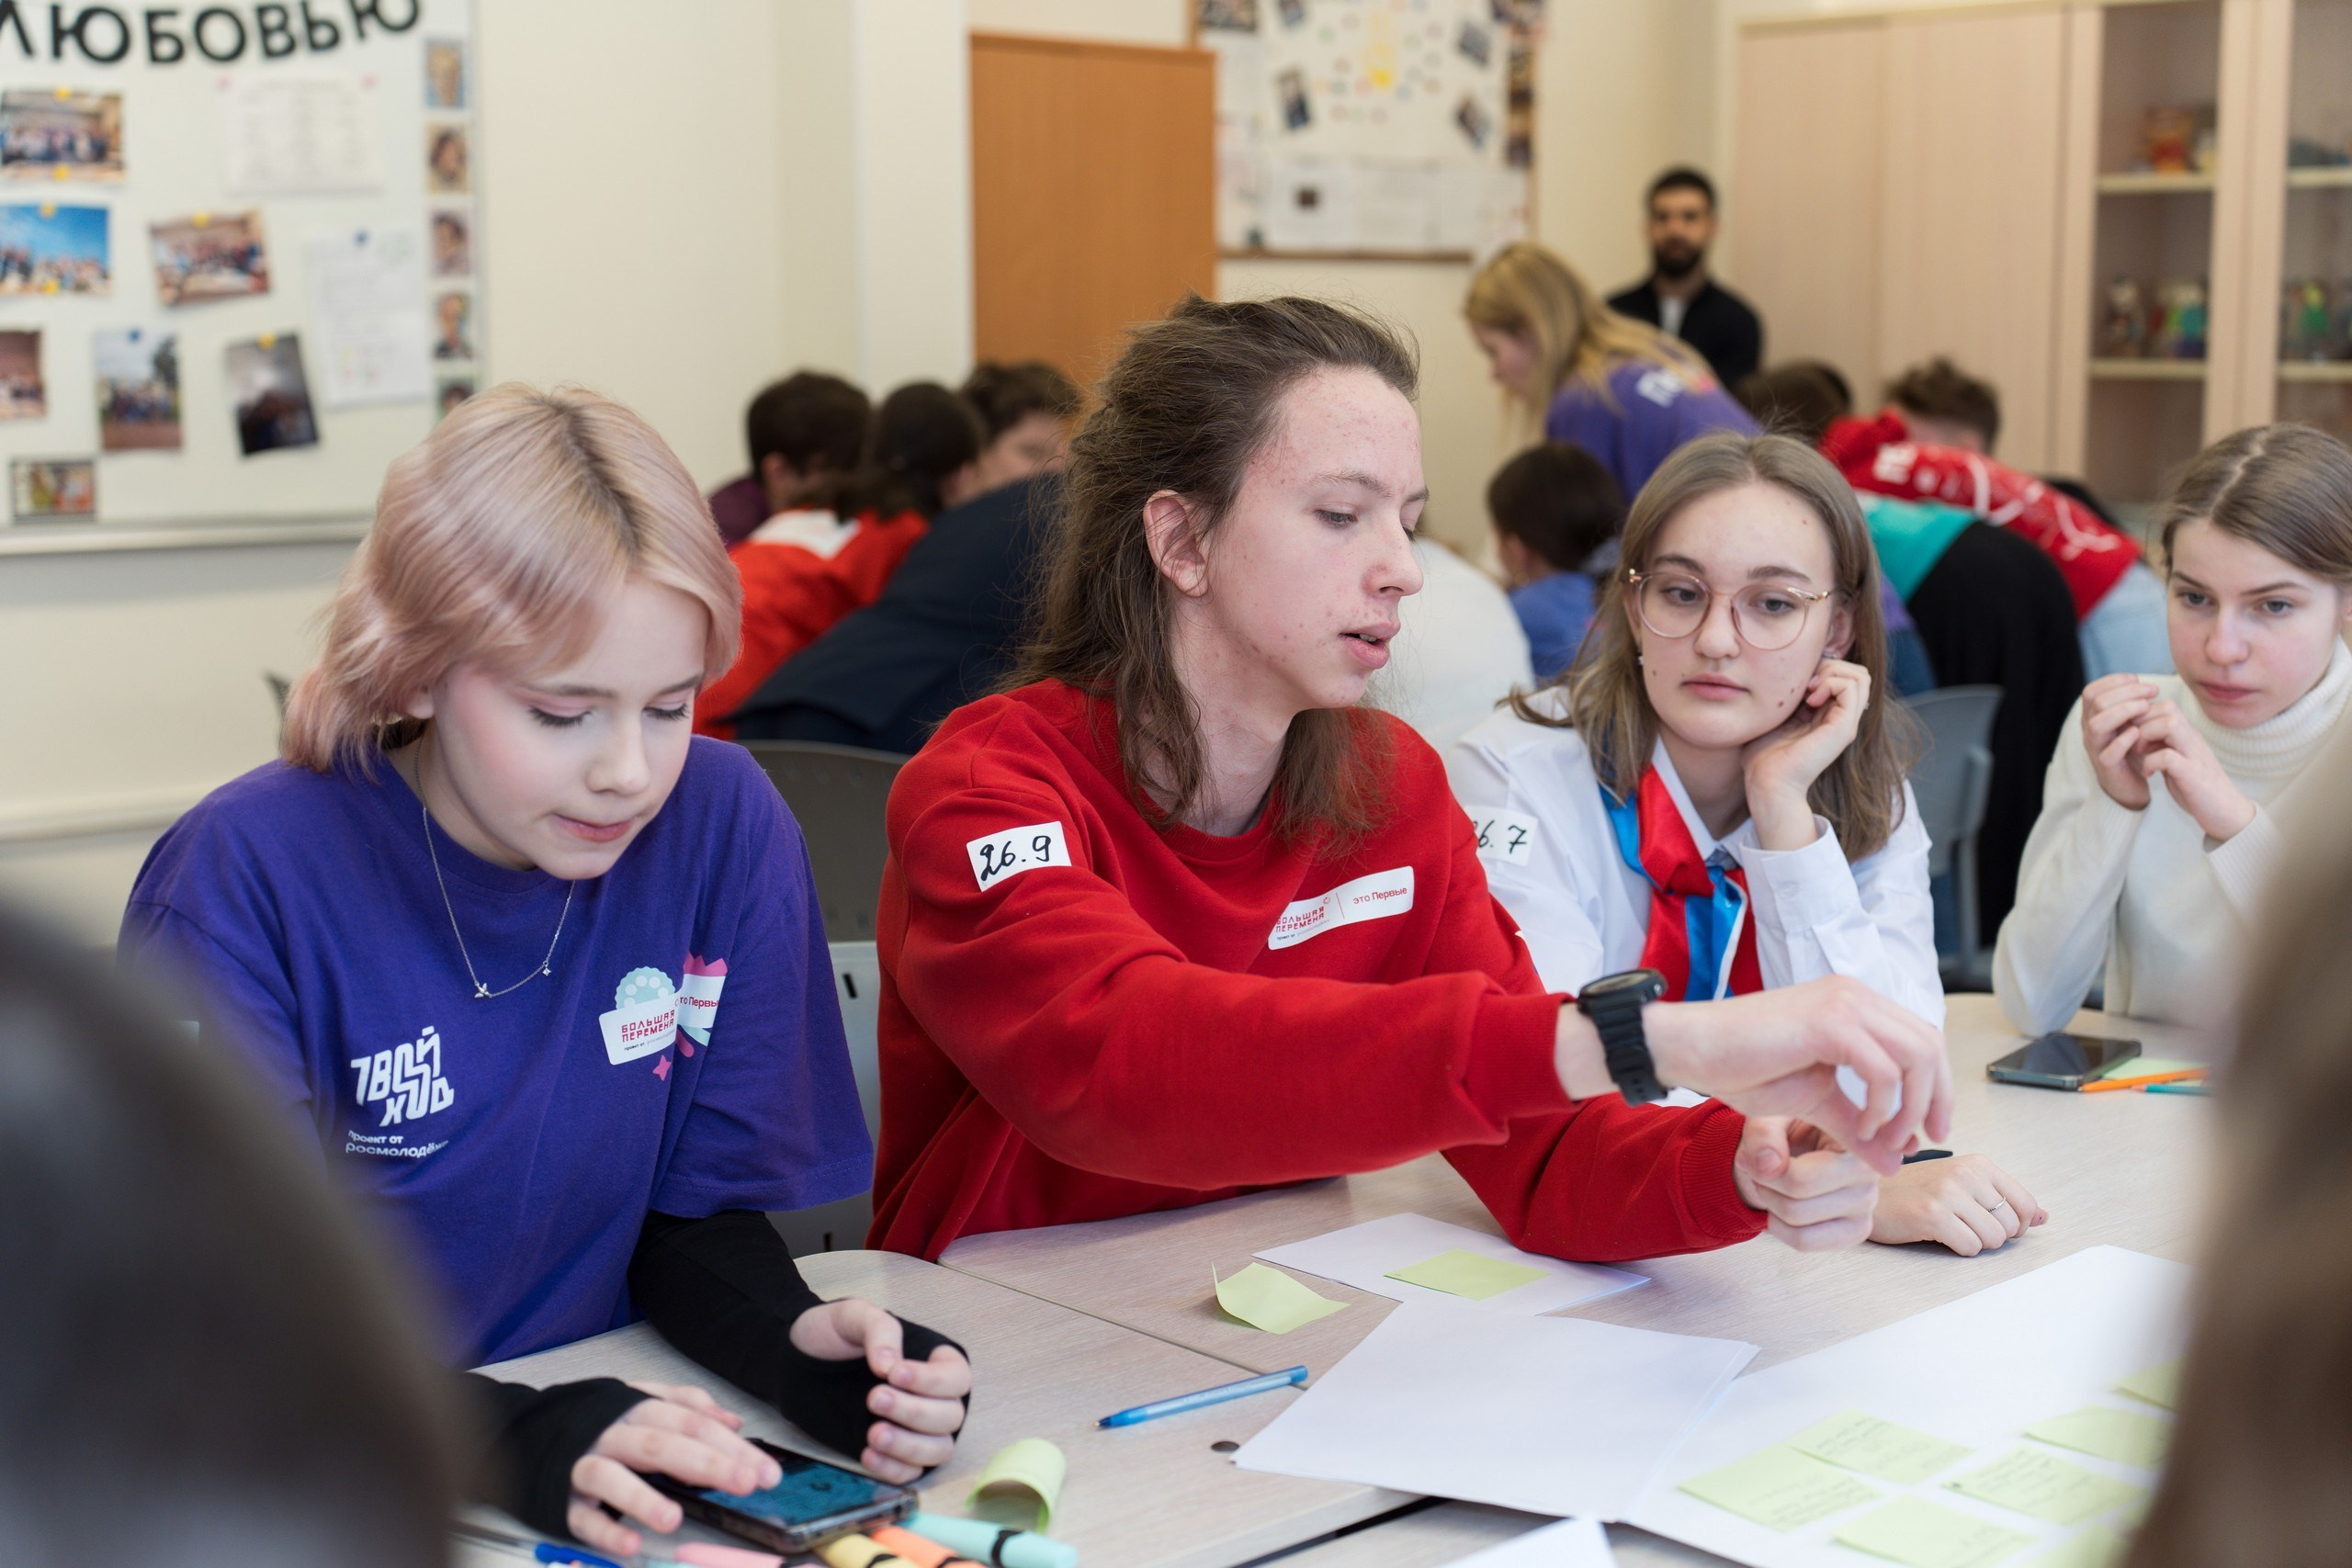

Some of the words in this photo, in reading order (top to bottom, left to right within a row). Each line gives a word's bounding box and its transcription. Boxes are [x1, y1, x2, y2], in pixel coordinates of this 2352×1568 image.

[1473, 819, 1527, 854] 6.7
[979, 835, 1052, 882] 26.9
[1352, 895, 1371, 904] это
[1372, 887, 1408, 900] Первые
[1276, 913, 1325, 932] ПЕРЕМЕНА
[689, 997, 719, 1010] Первы
[622, 1010, 675, 1033] БОЛЬШАЯ
[622, 1019, 674, 1043] ПЕРЕМЕНА
[348, 1130, 387, 1144] проект
[389, 1135, 404, 1145] от
